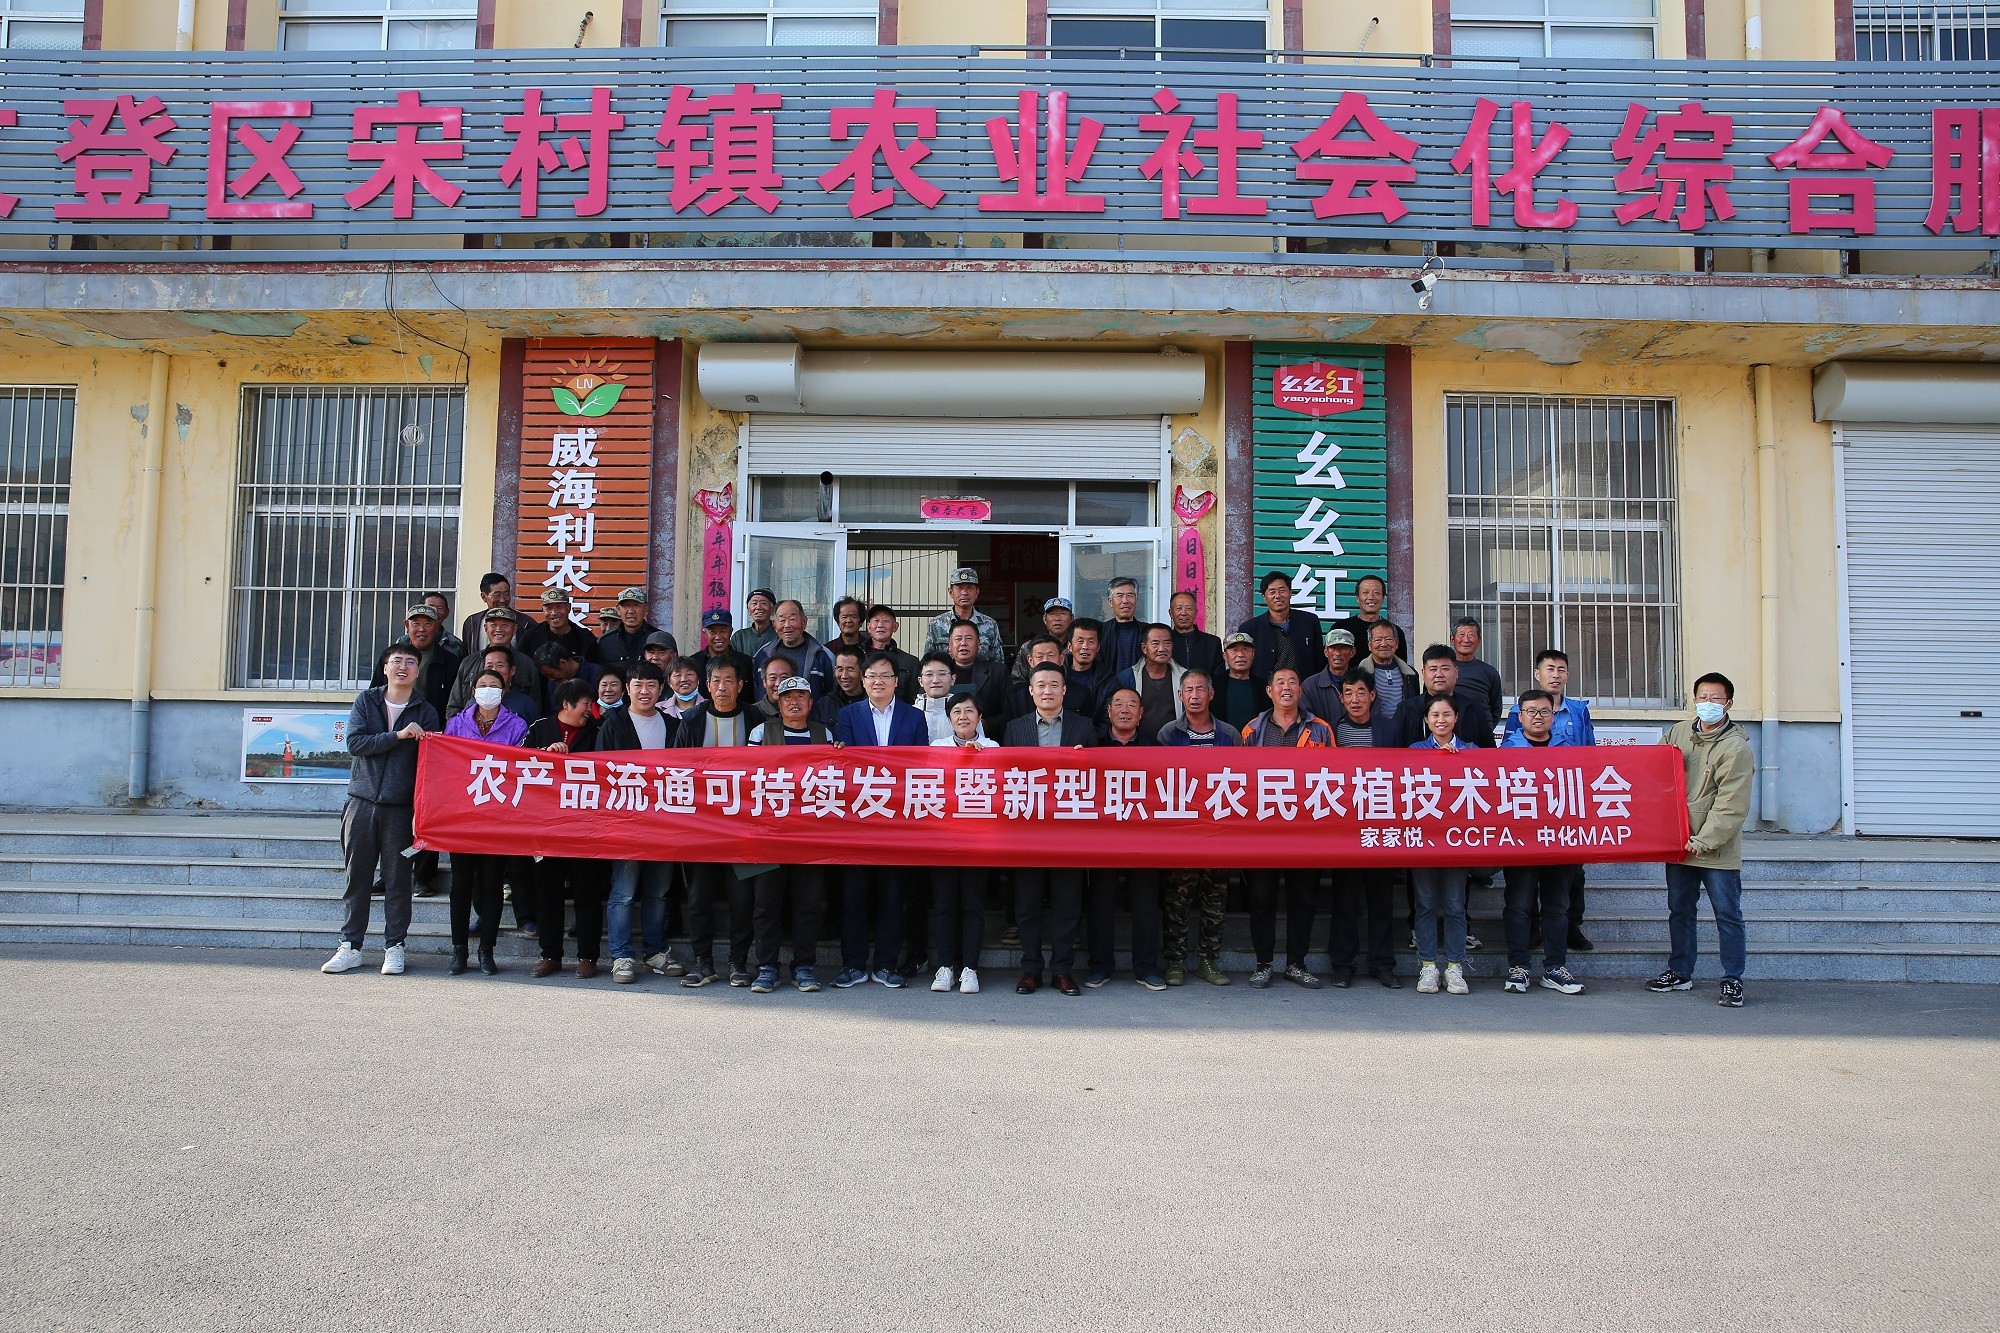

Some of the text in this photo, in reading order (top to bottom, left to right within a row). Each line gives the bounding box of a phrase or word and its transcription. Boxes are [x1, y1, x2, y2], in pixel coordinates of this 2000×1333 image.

[0, 83, 2000, 236] 登区宋村镇农业社会化综合服
[576, 378, 593, 389] LN
[1282, 396, 1354, 405] yaoyaohong
[1289, 430, 1351, 619] 幺幺红
[466, 754, 1633, 821] 农产品流通可持续发展暨新型职业农民农植技术培训会
